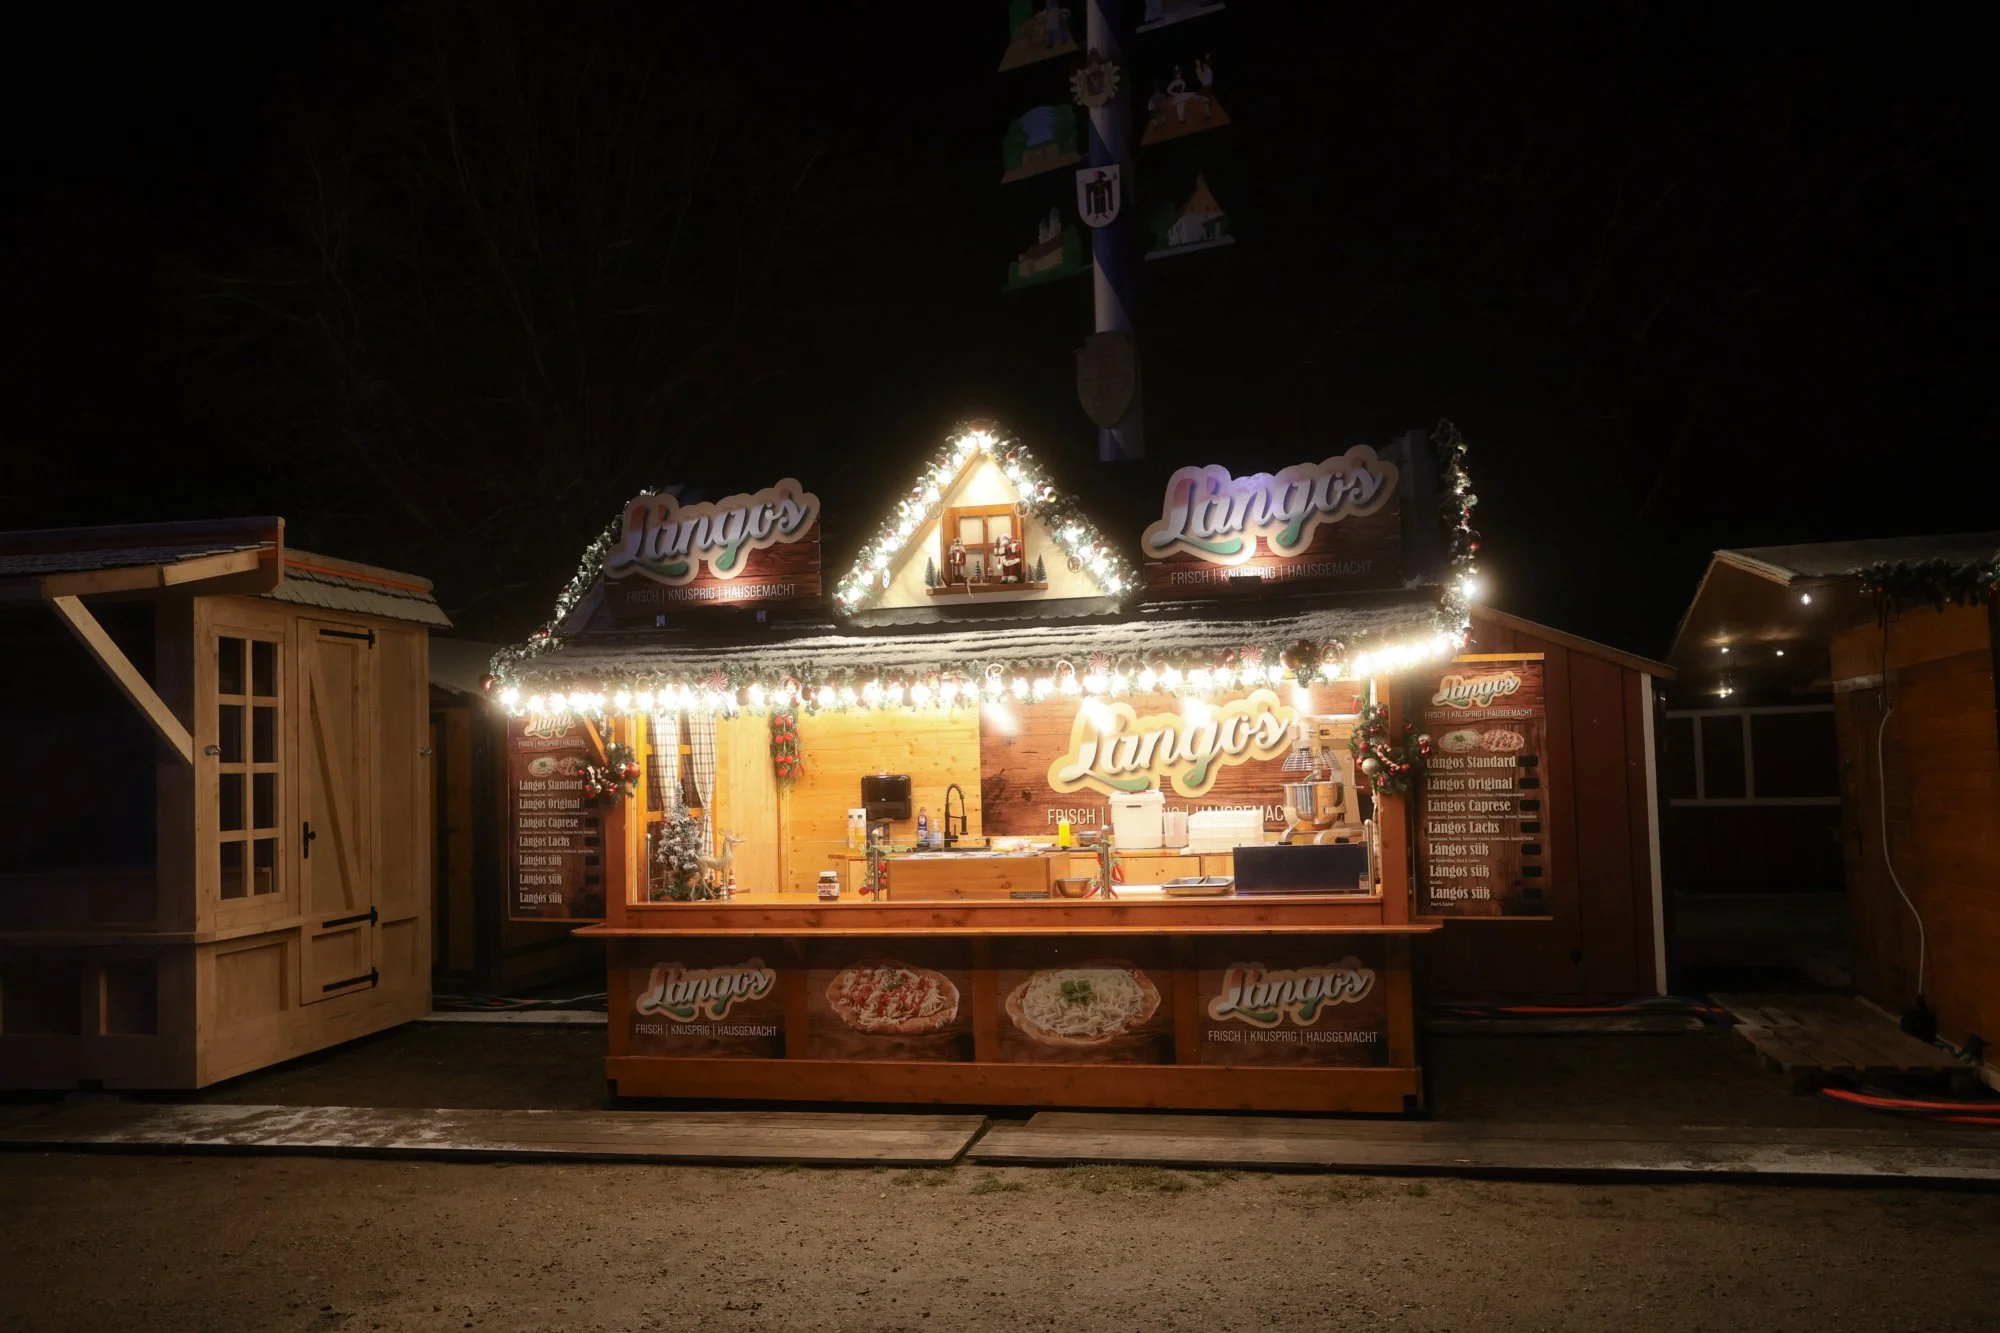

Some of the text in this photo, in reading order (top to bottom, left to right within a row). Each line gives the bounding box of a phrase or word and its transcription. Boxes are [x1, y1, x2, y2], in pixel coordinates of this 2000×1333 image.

[1171, 570, 1209, 585] FRISCH
[1287, 560, 1373, 579] HAUSGEMACHT
[626, 583, 797, 603] FRISCH KNUSPRIG HAUSGEMACHT
[1424, 708, 1533, 720] FRISCH KNUSPRIG HAUSGEMACHT
[1426, 755, 1517, 769] Lángos Standard
[548, 779, 583, 791] Standard
[1427, 777, 1513, 792] Lángos Original
[548, 798, 580, 811] Original
[1427, 799, 1511, 813] Lángos Caprese
[548, 817, 579, 829] Caprese
[1048, 808, 1096, 825] FRISCH
[1428, 821, 1500, 835] Lángos Lachs
[548, 836, 570, 847] Lachs
[1428, 843, 1489, 857] Lángos süß
[548, 854, 562, 867] süß
[1429, 865, 1490, 879] Lángos süß
[548, 873, 562, 886] süß
[548, 892, 563, 905] süß
[1471, 886, 1491, 900] süß
[636, 1023, 777, 1037] FRISCH KNUSPRIG HAUSGEMACHT
[1208, 1030, 1378, 1043] FRISCH KNUSPRIG HAUSGEMACHT
